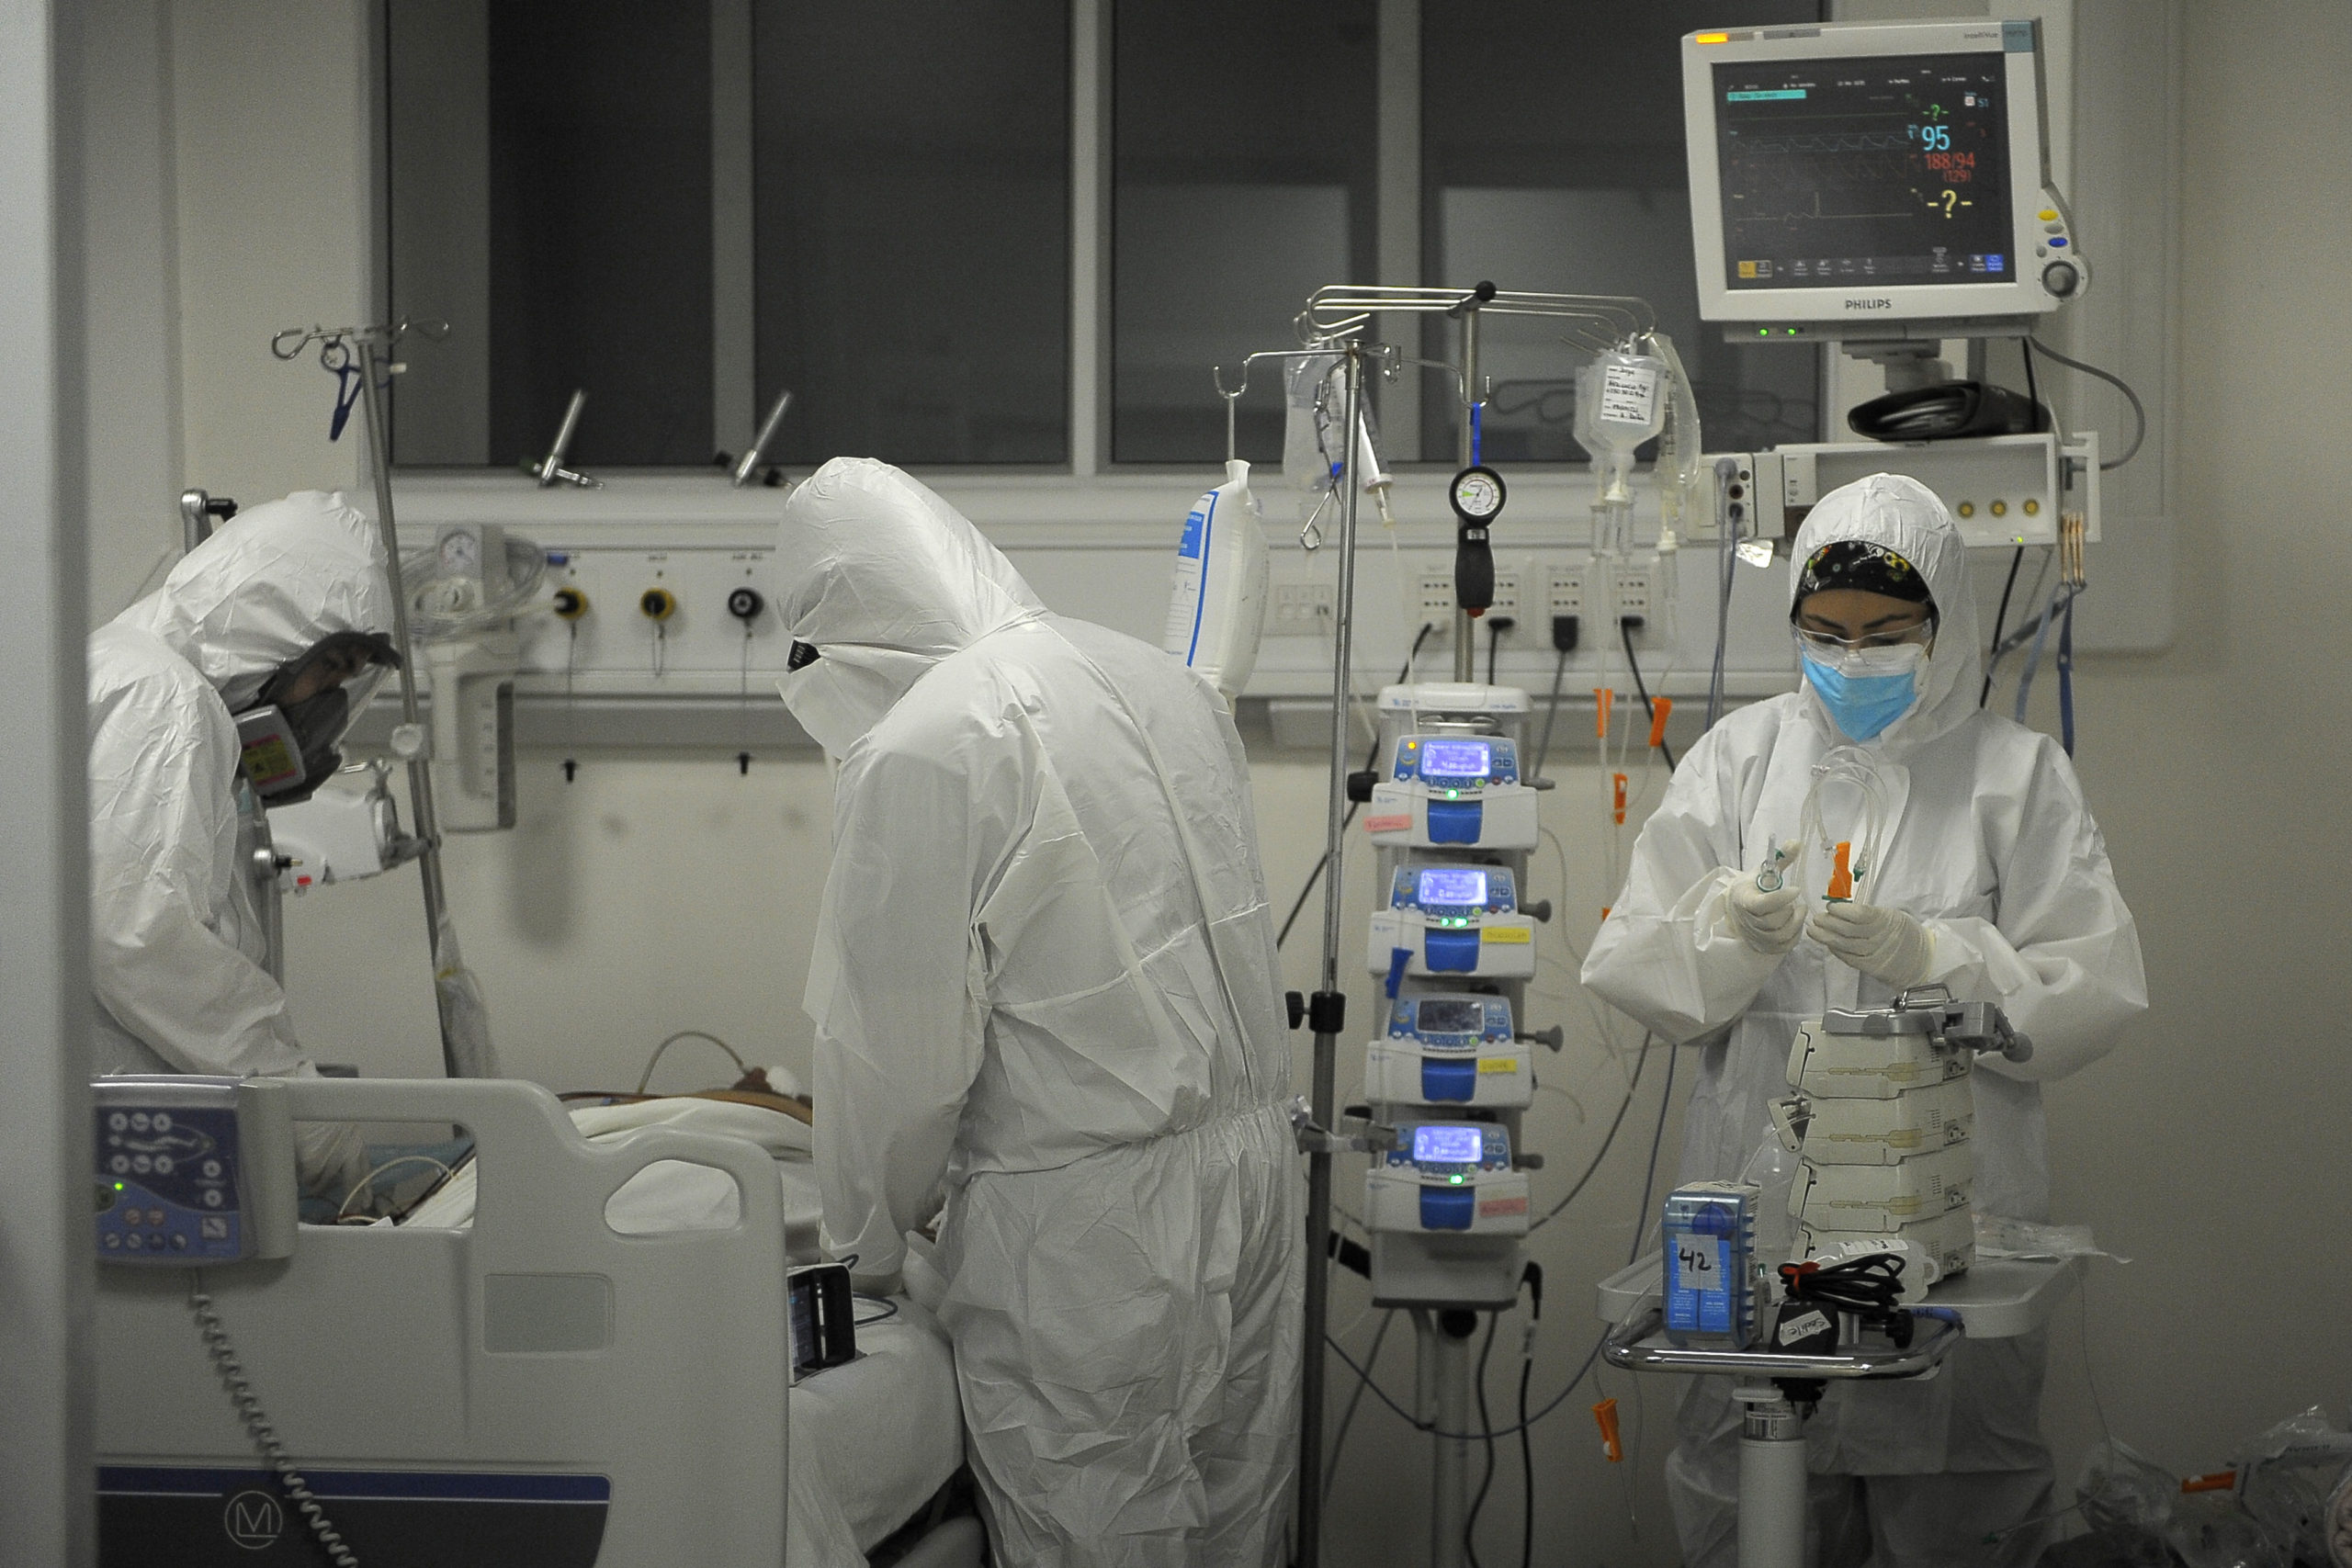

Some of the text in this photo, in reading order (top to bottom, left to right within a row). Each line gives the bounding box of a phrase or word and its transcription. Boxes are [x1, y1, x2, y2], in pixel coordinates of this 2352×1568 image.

[1921, 125, 1951, 152] 95
[1924, 152, 1975, 170] 188/94
[1845, 299, 1893, 310] PHILIPS
[1679, 1247, 1712, 1272] 42
